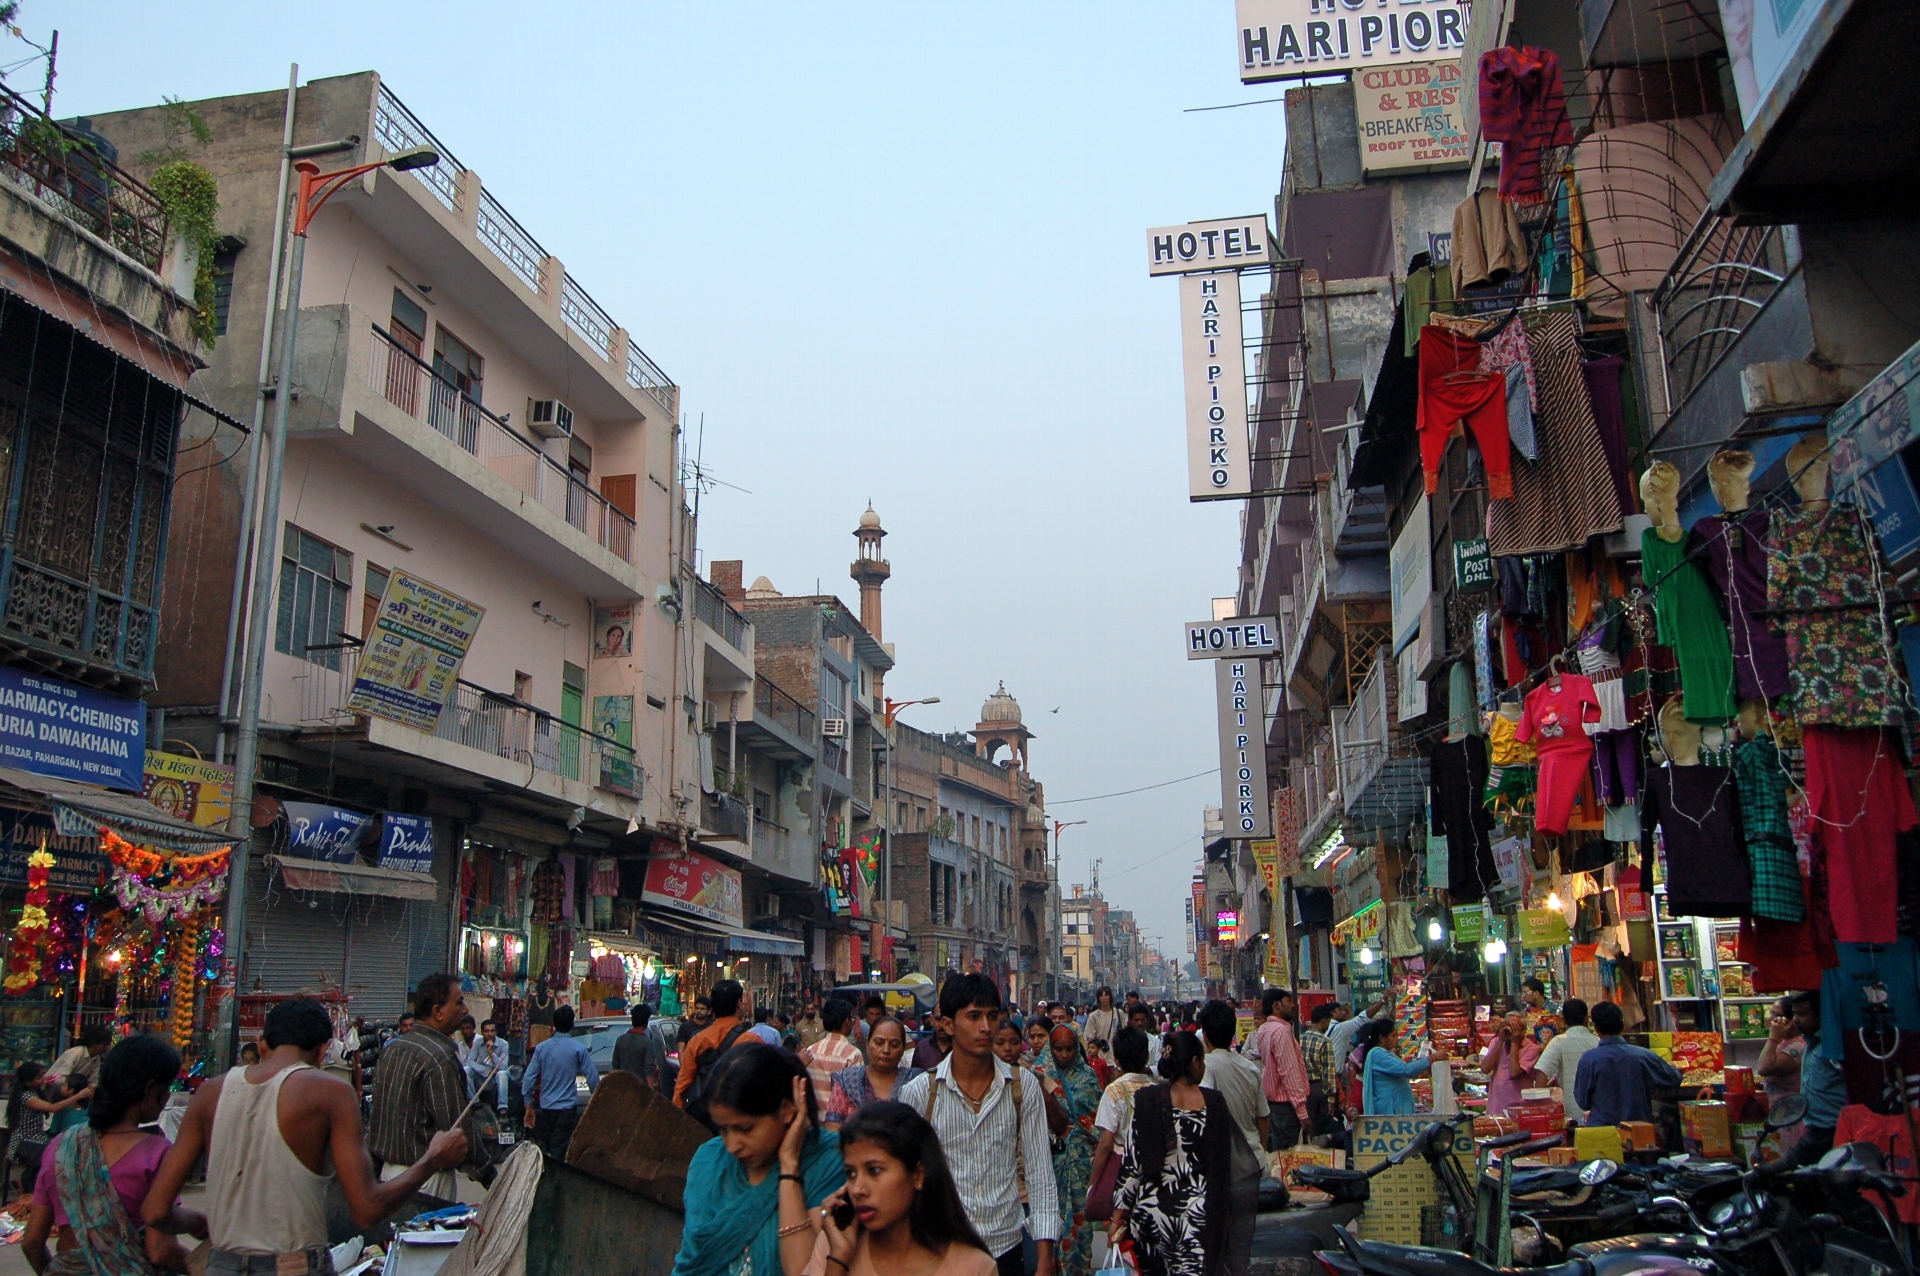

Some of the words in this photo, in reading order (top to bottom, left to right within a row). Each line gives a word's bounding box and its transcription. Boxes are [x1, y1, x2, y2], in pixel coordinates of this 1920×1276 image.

[1242, 17, 1350, 68] HARI
[1359, 8, 1470, 57] PIOR
[1363, 66, 1432, 90] CLUB
[1438, 63, 1462, 83] IN
[1378, 92, 1402, 112] &
[1407, 87, 1461, 109] RES
[1365, 113, 1458, 137] BREAKFAST,
[1368, 139, 1406, 153] ROOF
[1408, 138, 1437, 149] TOP
[1441, 134, 1468, 146] GAR
[1413, 147, 1468, 160] ELEVAT
[1153, 226, 1262, 264] HOTEL
[1437, 240, 1452, 263] SH
[1201, 278, 1221, 357] HARI
[1206, 364, 1230, 487] PIORKO
[1460, 541, 1487, 558] INDIAN
[1464, 558, 1490, 574] POST
[388, 601, 409, 616] श्री
[411, 609, 439, 628] राम
[439, 621, 470, 642] कथा
[1190, 623, 1274, 651] HOTEL
[23, 677, 41, 689] ESTD.
[42, 682, 61, 694] SINCE
[63, 687, 77, 698] 1928
[1231, 663, 1247, 727] HARI
[0, 687, 139, 737] ARMACY-CHEMISTS
[0, 714, 35, 738] URIA
[39, 722, 129, 759] DAWAKHANA
[5, 745, 33, 761] BAZAR,
[35, 751, 82, 771] PAHARGANJ,
[83, 761, 100, 773] NEW
[100, 765, 122, 777] DELHI
[167, 758, 197, 777] मंडल
[1237, 734, 1255, 832] PIORKO
[13, 822, 106, 856] DAWAKHAN
[381, 856, 416, 872] READYMADE
[415, 859, 432, 873] STORE
[668, 861, 678, 873] day
[678, 865, 690, 876] with
[696, 940, 718, 955] STORE
[1364, 1120, 1464, 1136] PARC
[1357, 1136, 1473, 1153] PACG
